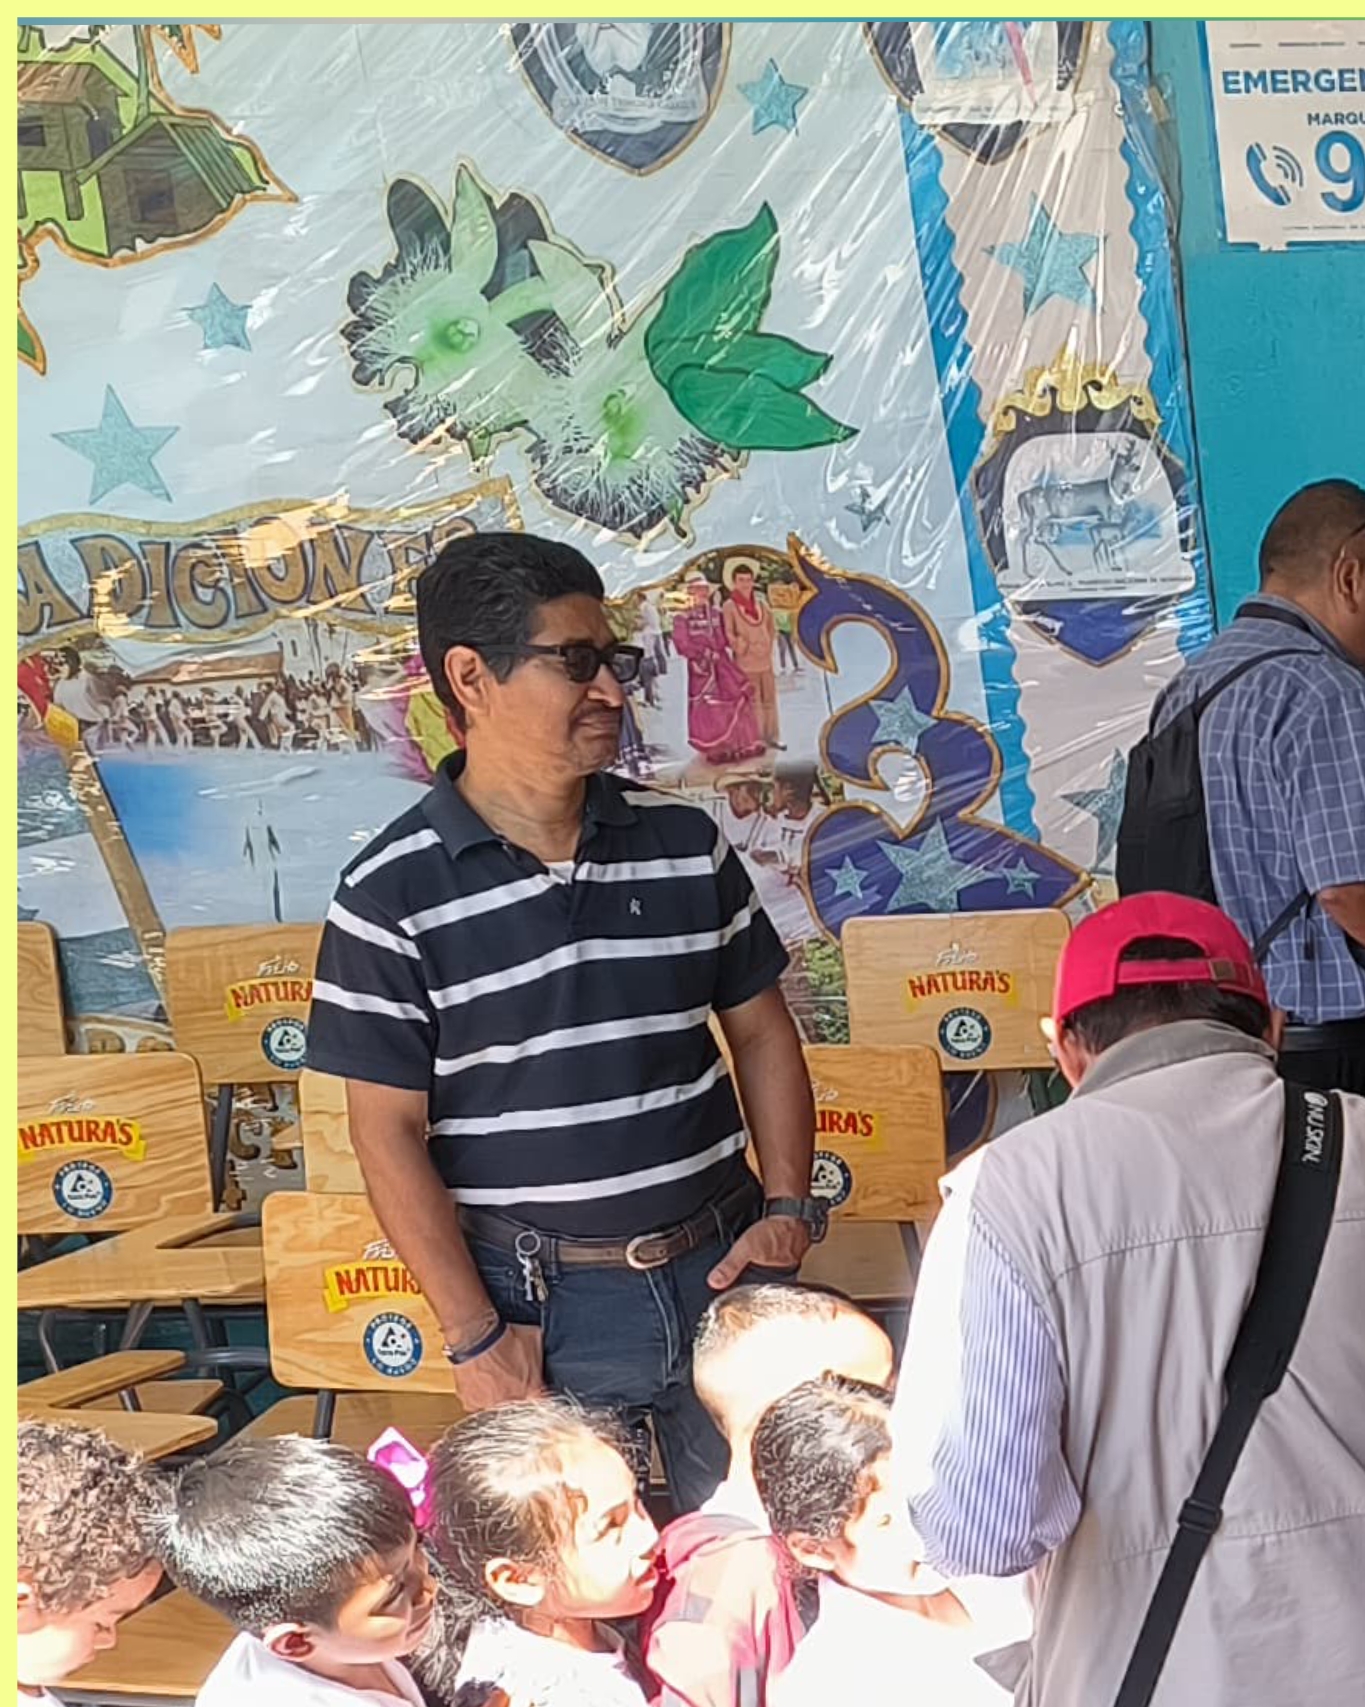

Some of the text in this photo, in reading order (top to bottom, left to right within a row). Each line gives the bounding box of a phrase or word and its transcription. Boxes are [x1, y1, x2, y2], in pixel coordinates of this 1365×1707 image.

[908, 969, 1010, 998] NATURA'S
[18, 1119, 133, 1150] NATURA'S
[335, 1266, 421, 1295] NATUR
